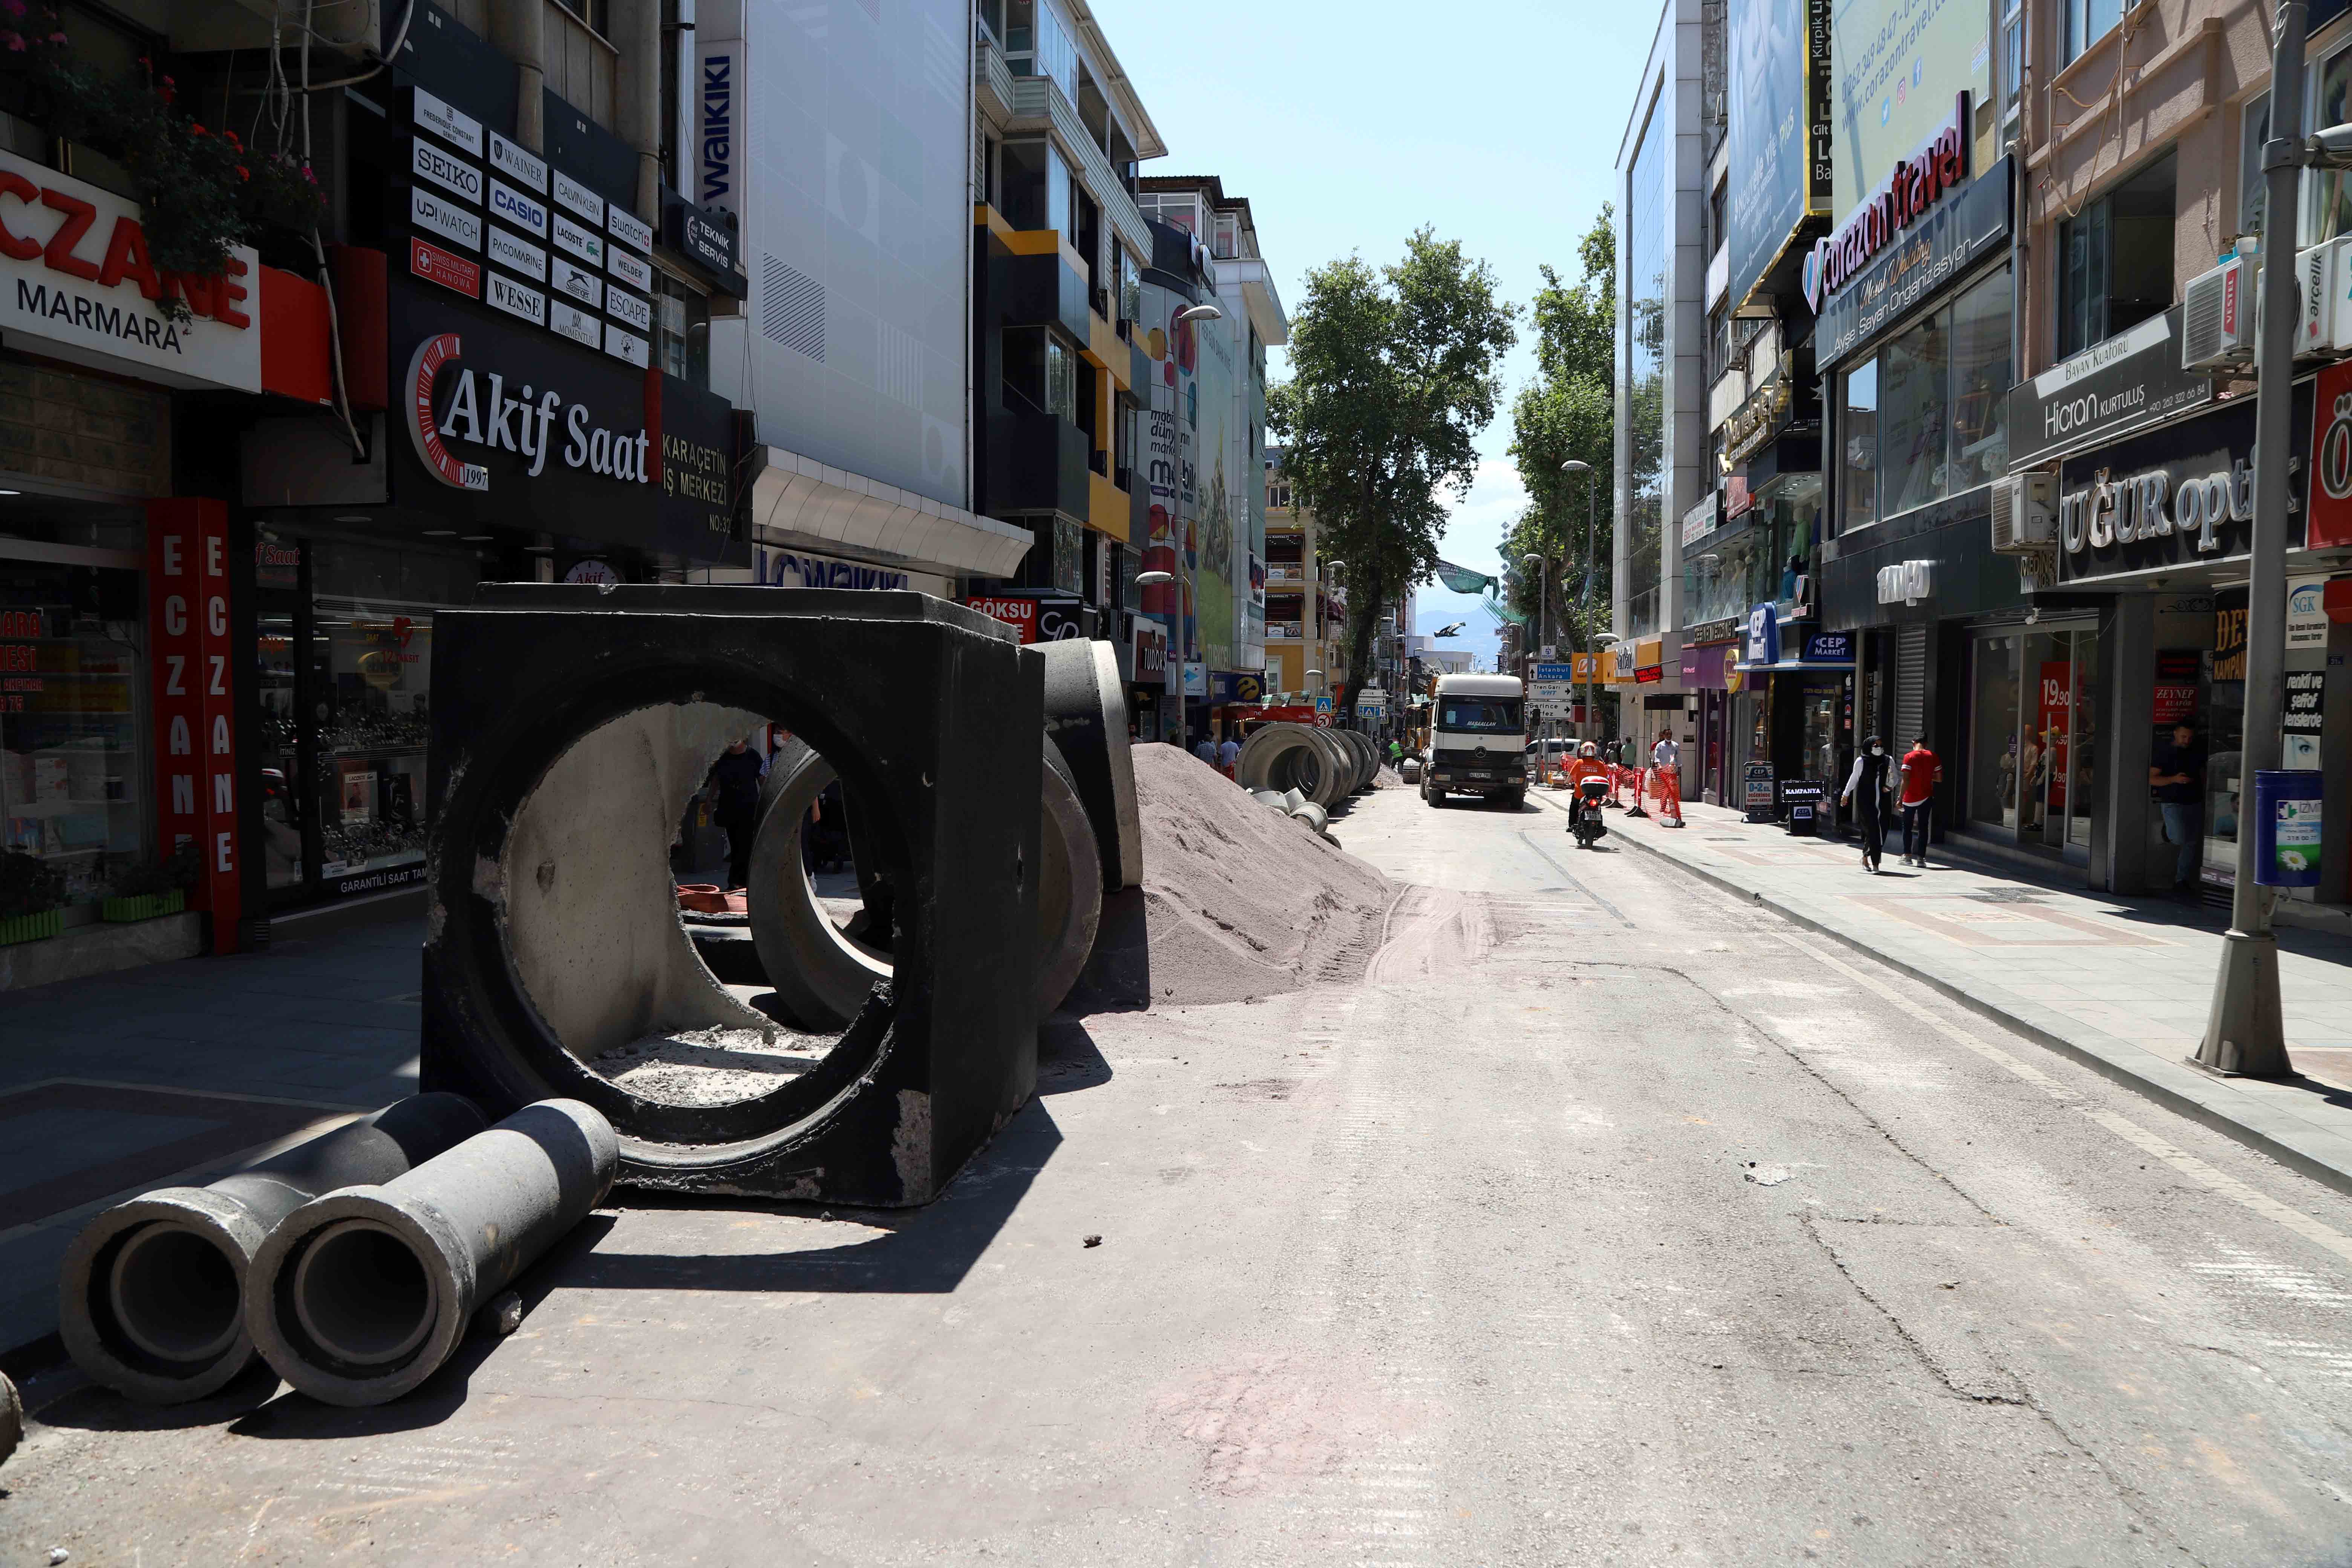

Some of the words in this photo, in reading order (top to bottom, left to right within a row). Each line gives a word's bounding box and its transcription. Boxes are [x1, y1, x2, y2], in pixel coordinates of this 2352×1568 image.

[1812, 17, 1825, 58] Kirpik
[1848, 62, 1860, 96] 262
[1862, 43, 1875, 77] 349
[1877, 27, 1885, 55] 48
[1888, 10, 1897, 40] 47
[424, 109, 452, 130] FREDERIQUE
[452, 125, 474, 144] CONSTANT
[443, 130, 457, 142] GENEVE
[1812, 124, 1828, 135] Cilt
[418, 148, 478, 194] SEIKO
[504, 149, 543, 184] WAINER
[558, 183, 582, 206] CALVIN
[582, 197, 599, 216] KLEIN
[1823, 191, 1889, 296] corazon
[1891, 90, 1965, 230] travel
[495, 189, 542, 227] CASIO
[439, 209, 477, 241] WATCH
[557, 225, 583, 248] LACOSTE
[612, 216, 645, 241] swatch
[699, 220, 729, 251] TEKNİK
[432, 252, 450, 267] SWISS
[451, 260, 475, 277] MILITARY
[493, 238, 543, 271] PACOMARINE
[698, 240, 728, 268] SERVİS
[1887, 238, 1931, 286] Wedding
[436, 268, 470, 290] HANOWA
[618, 259, 642, 280] WELDER
[493, 279, 541, 317] WESSE
[565, 282, 590, 299] Slazenger
[1834, 329, 1856, 354] Ayşe
[1859, 304, 1888, 335] Sayan
[1890, 238, 1971, 311] Organizasyon
[2310, 252, 2322, 317] arçelik
[17, 278, 182, 354] MARMARA
[610, 291, 647, 325] ESCAPE
[559, 325, 593, 346] MOMENTUS
[2045, 392, 2097, 439] Hicran
[2100, 383, 2145, 418] KURTULUŞ
[2149, 400, 2161, 413] +90
[2162, 397, 2173, 410] 262
[2174, 392, 2185, 404] 322
[2187, 388, 2195, 400] 66
[439, 368, 560, 477] Akif
[564, 404, 650, 484] Saat
[662, 433, 726, 476] KARAÇETİN
[465, 467, 487, 488] 1997
[663, 462, 674, 497] İŞ
[680, 472, 727, 506] MERKEZİ
[2062, 467, 2174, 554] UĞUR
[265, 545, 301, 566] Saat
[969, 597, 1032, 619] GÖKSU
[2293, 596, 2316, 613] SGK
[1814, 647, 1846, 655] MARKET
[1819, 637, 1843, 648] CEP
[1144, 647, 1167, 672] TUDORS
[2043, 678, 2069, 706] 19.90
[2156, 689, 2195, 699] ZEYNEP
[2286, 672, 2312, 689] renkli
[2312, 675, 2323, 689] ve
[206, 536, 233, 872] ECZANE
[2291, 693, 2318, 710] şeffaf
[2284, 712, 2323, 727] lenslerde
[340, 873, 386, 893] GARANTİLİ
[388, 871, 409, 883] SAAT
